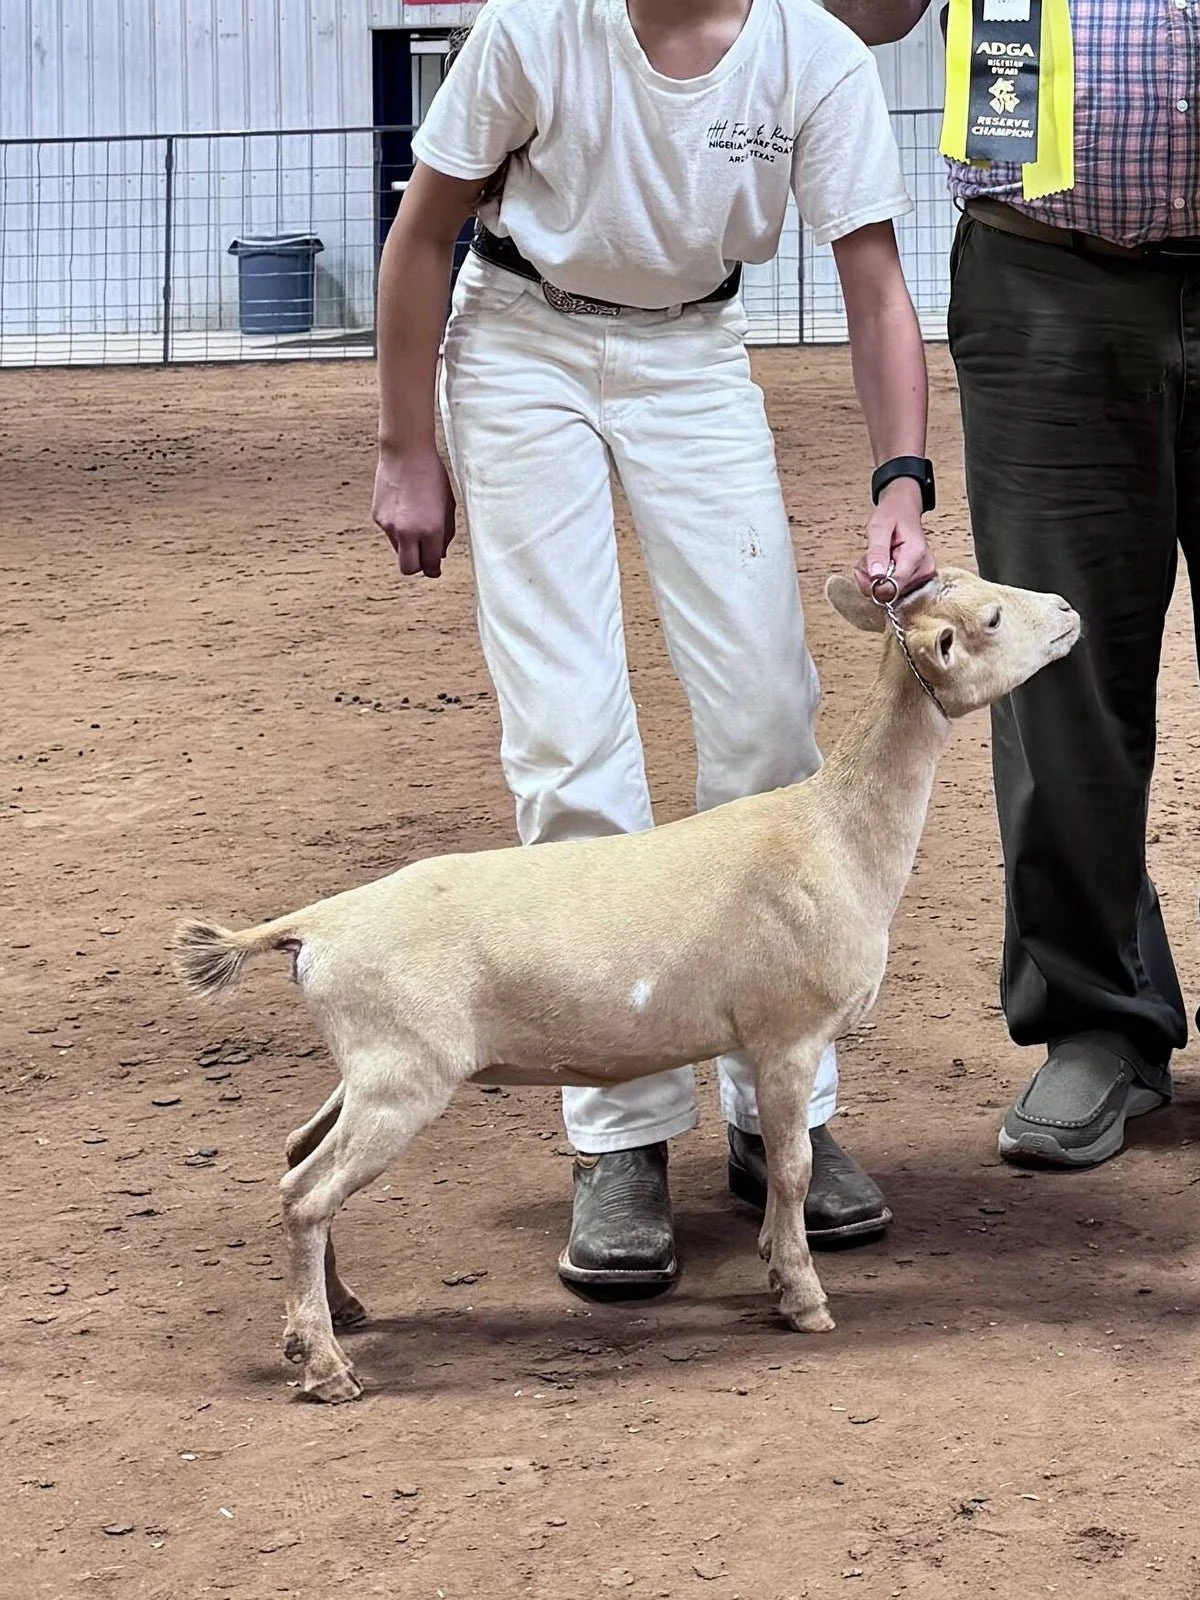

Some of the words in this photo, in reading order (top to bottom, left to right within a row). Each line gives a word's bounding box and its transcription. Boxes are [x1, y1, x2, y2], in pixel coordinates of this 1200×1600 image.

[976, 41, 1035, 57] ADGA
[977, 116, 1030, 128] RESERVE
[971, 125, 1034, 138] CHAMPION
[746, 138, 770, 149] WARF
